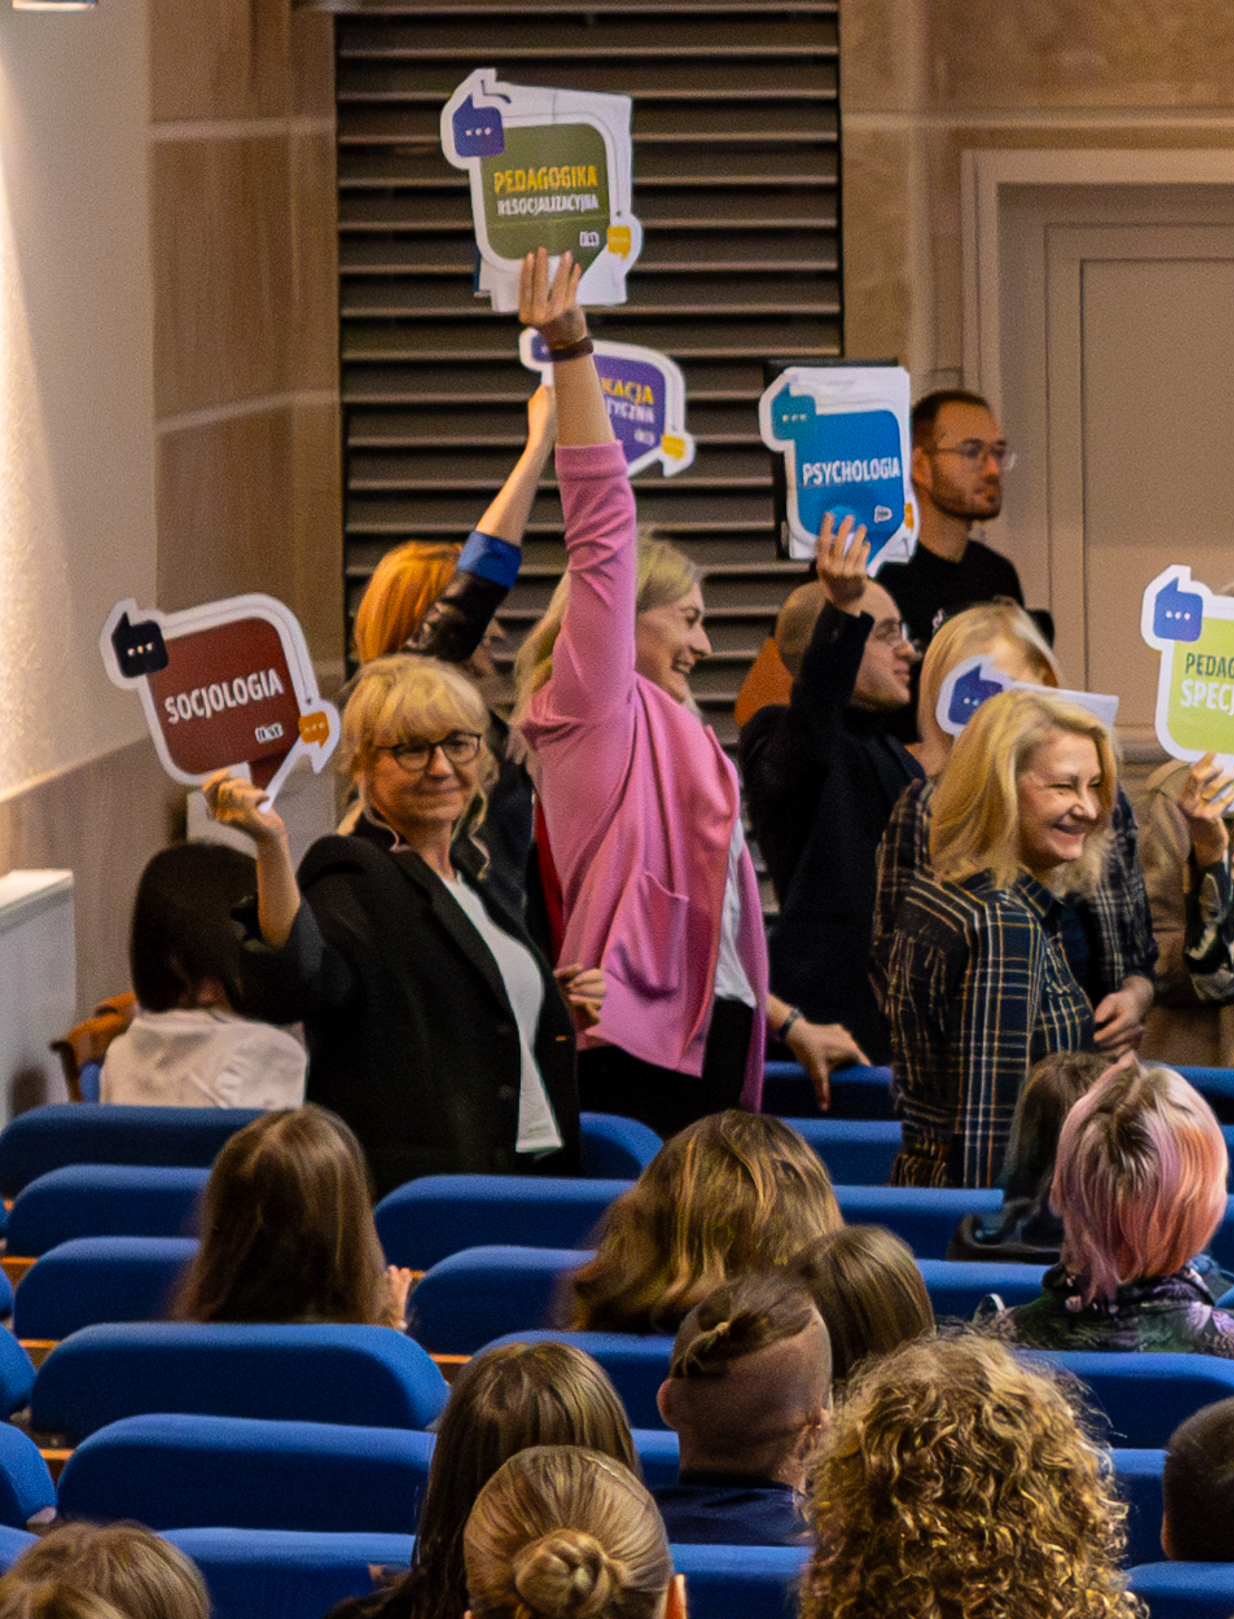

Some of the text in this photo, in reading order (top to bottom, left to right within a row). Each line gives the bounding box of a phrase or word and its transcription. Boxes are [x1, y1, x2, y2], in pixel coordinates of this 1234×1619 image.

[493, 165, 598, 195] PEDAGOGIKA
[600, 377, 655, 405] KACJA
[802, 457, 900, 486] PSYCHOLOGIA
[164, 668, 285, 724] SOCJOLOGIA
